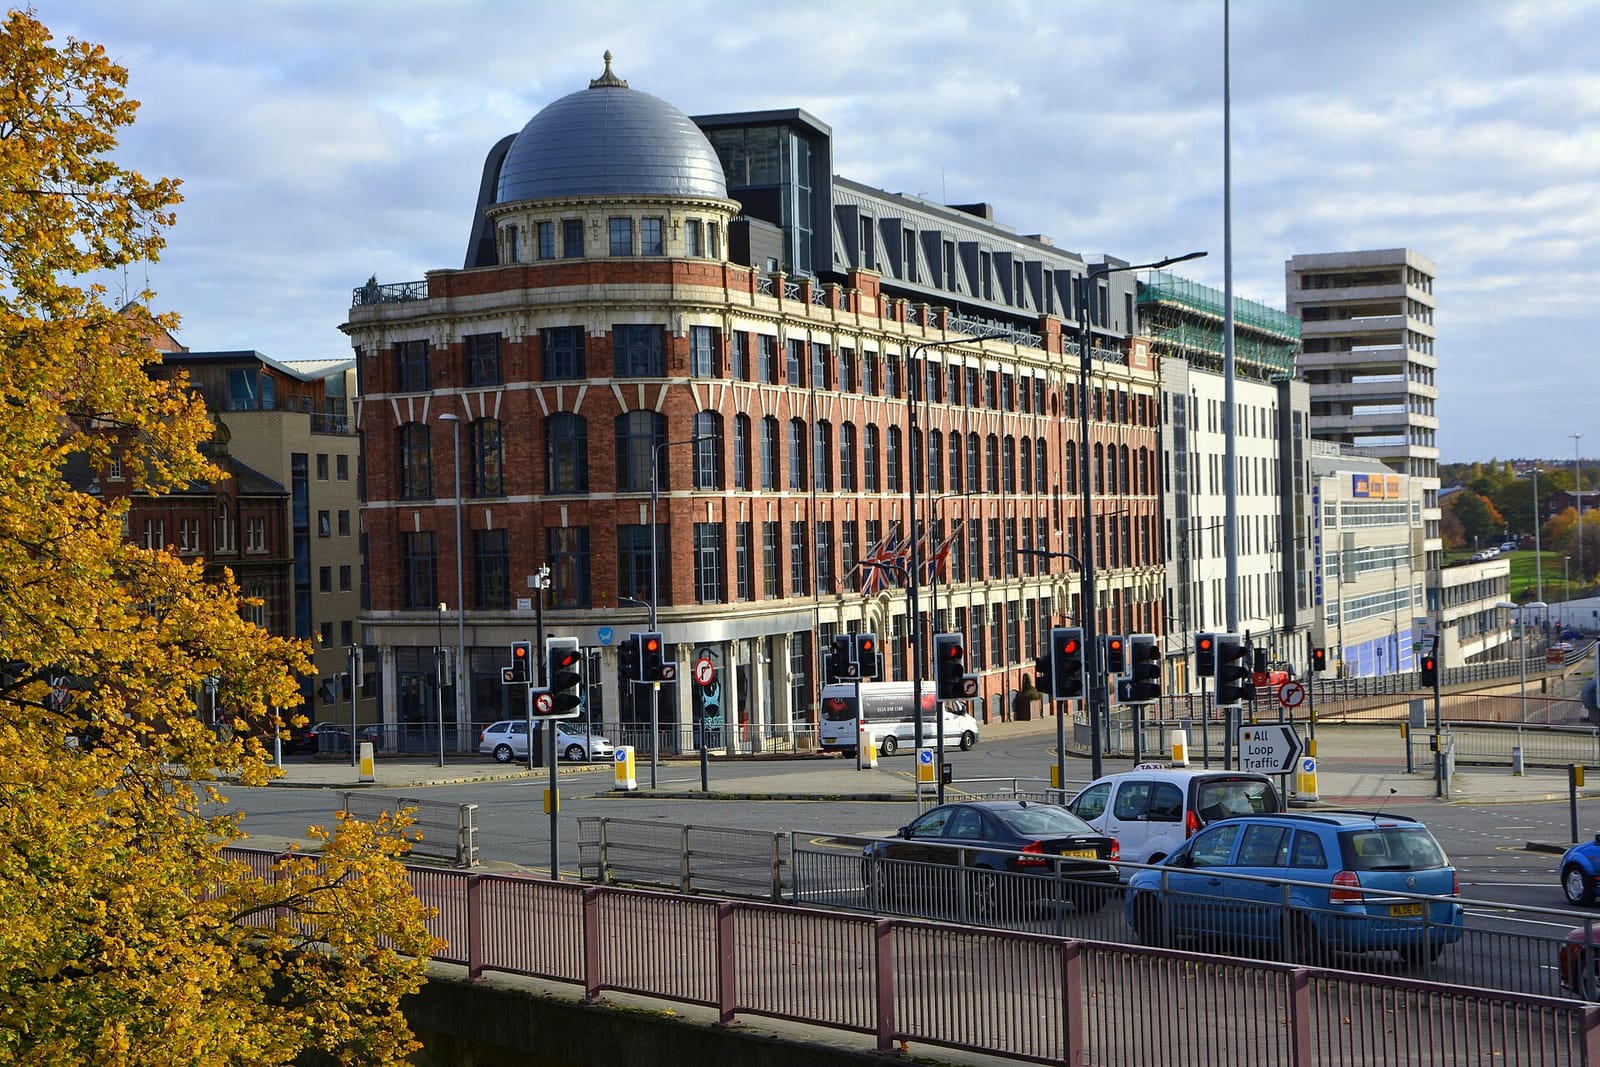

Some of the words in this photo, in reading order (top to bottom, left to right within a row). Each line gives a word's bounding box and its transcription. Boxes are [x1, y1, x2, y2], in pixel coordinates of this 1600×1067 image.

[1254, 730, 1268, 741] All
[1248, 745, 1274, 756] Loop
[1243, 757, 1279, 769] Traffic
